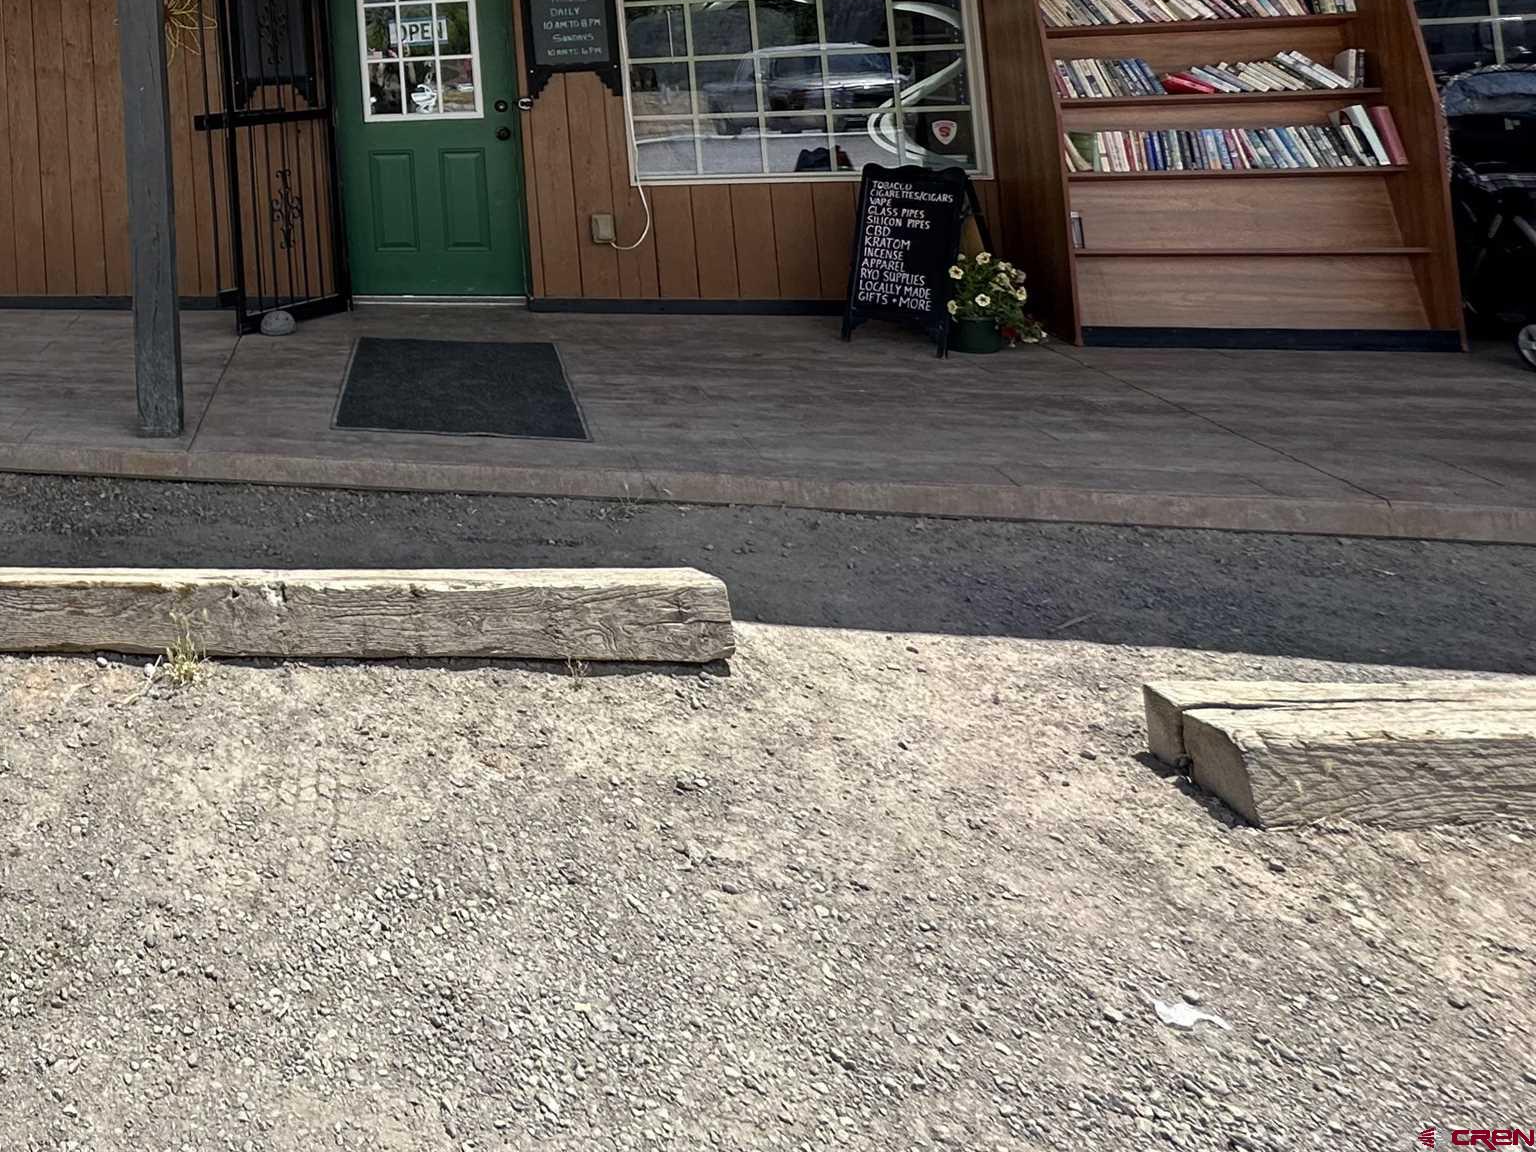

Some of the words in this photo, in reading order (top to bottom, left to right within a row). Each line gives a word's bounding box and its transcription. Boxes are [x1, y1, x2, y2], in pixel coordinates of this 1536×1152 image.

[551, 8, 580, 17] DAILY
[872, 181, 912, 191] TOBACCO
[870, 197, 892, 207] VAPE
[871, 189, 954, 203] CIGARETTES/CIGARS
[868, 206, 898, 217] GLASS
[902, 209, 926, 219] PIPES
[867, 216, 902, 227] SILICON
[907, 219, 932, 230] PIPES
[866, 225, 890, 237] CBD
[865, 236, 910, 251] KRATOM
[864, 247, 904, 261] INCENSE
[862, 258, 904, 273] APPAREL
[861, 268, 880, 281] RYO
[883, 271, 926, 286] SUPPLIES
[860, 280, 902, 295] LOCALLY
[904, 286, 932, 300] MADE
[859, 292, 888, 305] GIFTS
[899, 296, 932, 312] MORE
